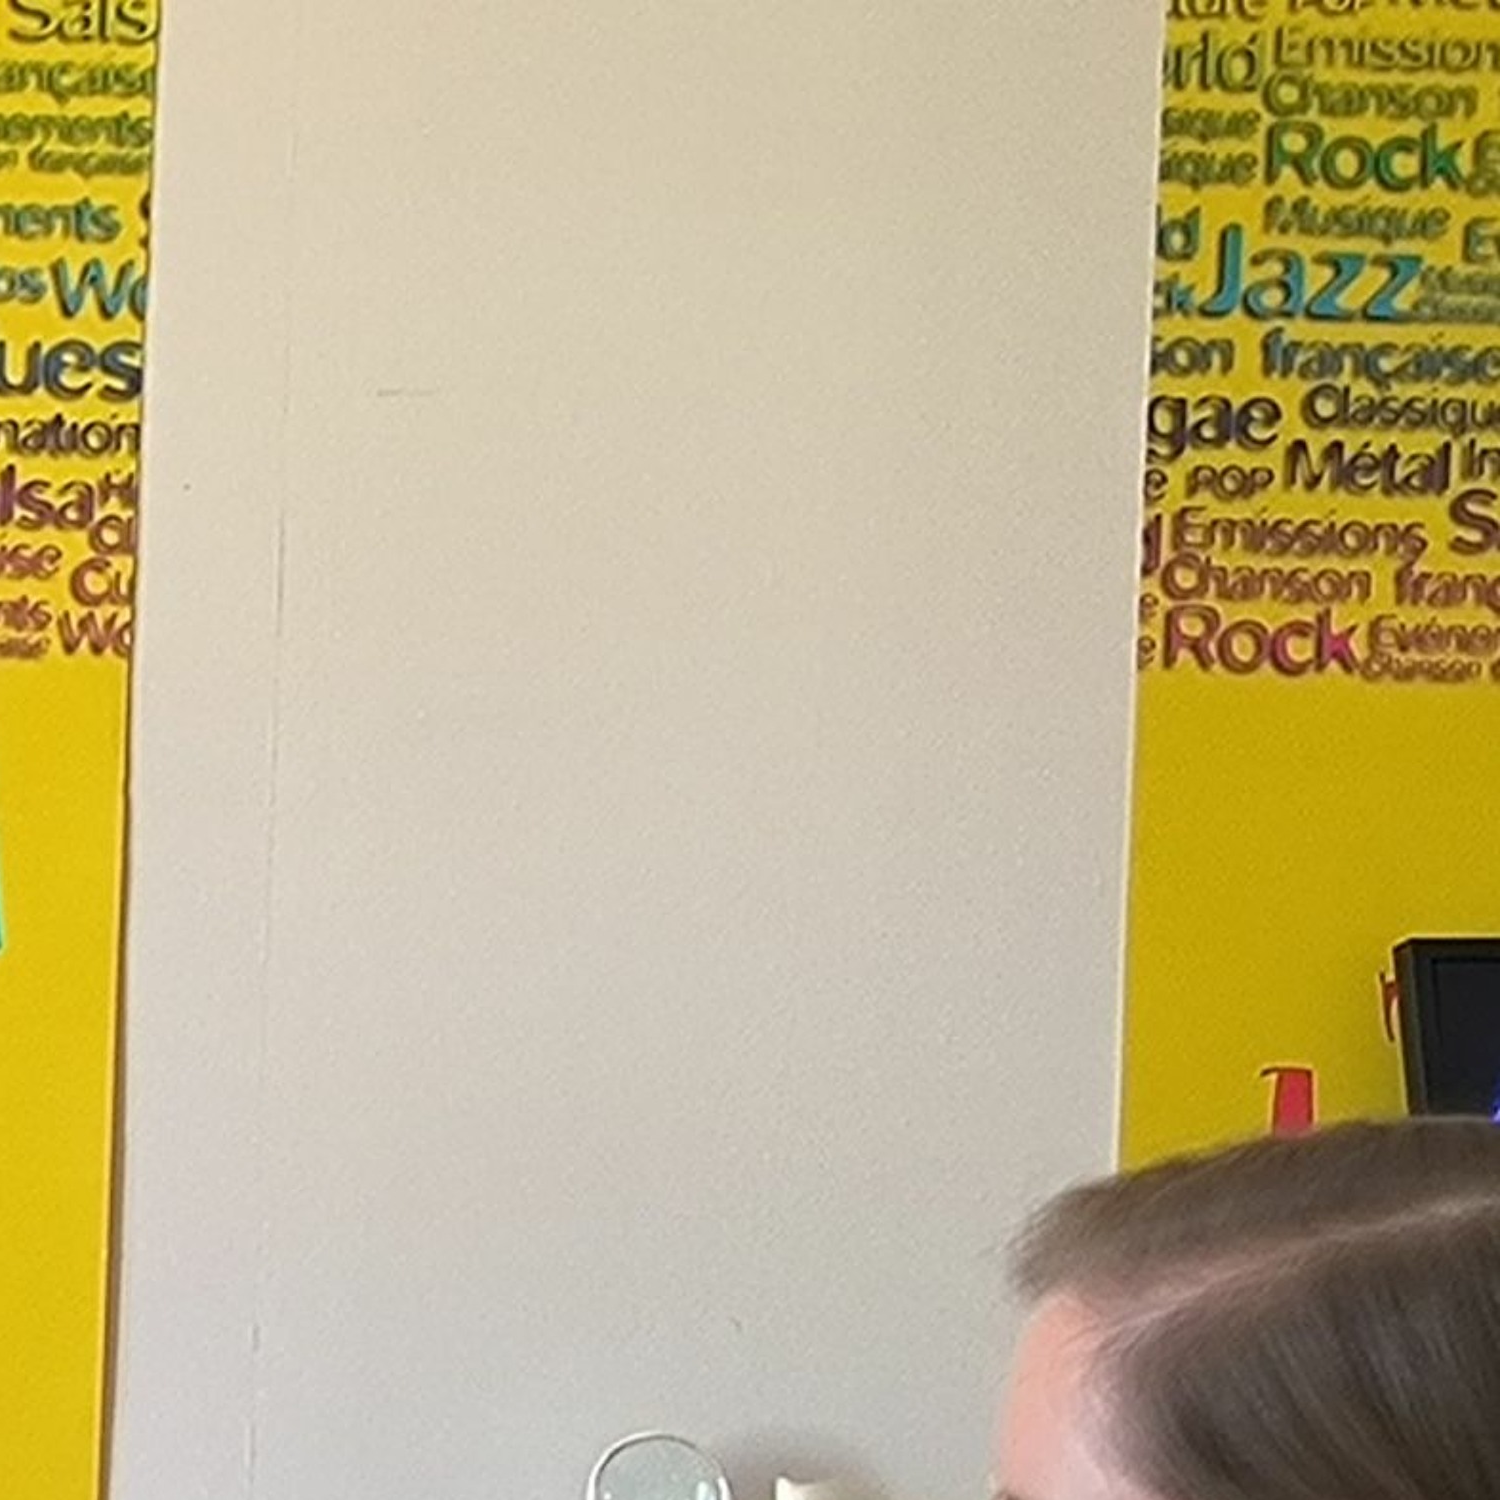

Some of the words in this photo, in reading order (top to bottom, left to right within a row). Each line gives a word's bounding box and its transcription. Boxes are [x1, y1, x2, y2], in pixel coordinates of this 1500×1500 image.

[1163, 28, 1258, 93] rld
[1262, 68, 1478, 121] Chanson
[1264, 117, 1466, 193] Rock
[1198, 220, 1425, 323] Jazz
[1282, 438, 1452, 498] Métal
[1171, 505, 1429, 560] Emissions
[1159, 552, 1373, 605] Chanson
[1162, 604, 1360, 677] Rock
